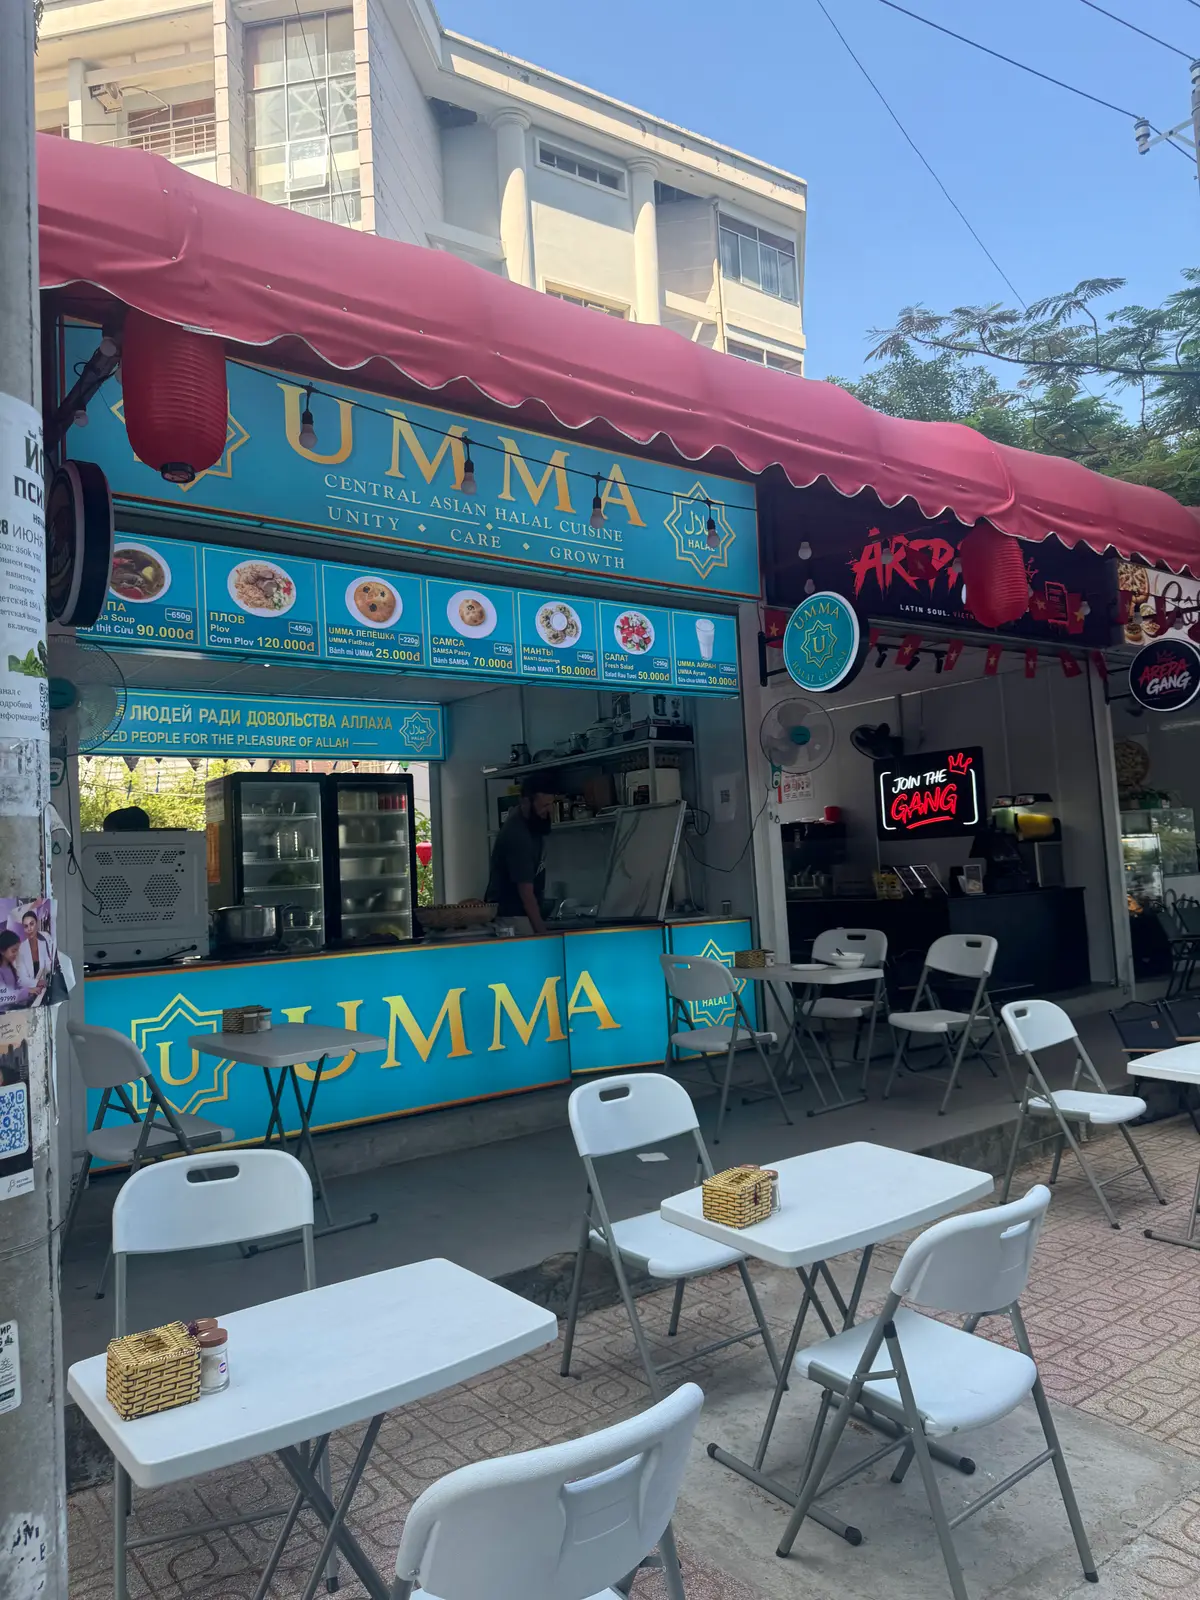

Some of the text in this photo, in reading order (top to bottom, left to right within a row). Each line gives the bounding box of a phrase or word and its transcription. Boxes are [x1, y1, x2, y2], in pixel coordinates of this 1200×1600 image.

[277, 383, 647, 527] UMMA
[324, 473, 623, 543] CENTRAL ASIAN HALAL CUISINE
[328, 506, 625, 570] UNITY CARE GROWTH
[689, 539, 715, 552] HALA
[794, 602, 839, 630] UMMA
[900, 604, 923, 613] LATIN
[927, 608, 949, 617] SOUL.
[111, 613, 135, 624] Soup
[209, 611, 245, 624] ПЛОВ
[136, 624, 194, 640] 90.000đ
[210, 623, 230, 633] Plov
[328, 627, 395, 640] UMMA ЛЕПЁШКА
[234, 636, 254, 646] Plov
[257, 636, 315, 652] 120.000đ
[432, 636, 465, 647] САМСА
[812, 635, 825, 653] U
[375, 648, 421, 661] 25.000đ
[523, 647, 554, 656] МАНТЫ
[604, 652, 629, 662] САЛАТ
[473, 656, 513, 669] 70.000đ
[556, 665, 597, 677] 150.000đ
[638, 671, 670, 681] 50.000đ
[1138, 658, 1189, 689] AREPA
[707, 676, 736, 686] 30.000đ
[1146, 670, 1192, 695] GANG
[130, 704, 193, 725] ЛЮДЕЙ
[199, 708, 241, 727] РАДИ
[246, 710, 337, 729] ДОВОЛЬСТВА
[341, 715, 393, 731] АЛЛАХА
[131, 731, 181, 744] PEOPLE
[184, 732, 208, 745] FOR
[211, 733, 234, 746] THE
[237, 734, 296, 748] PLEASURE
[298, 736, 313, 748] OF
[315, 737, 349, 749] ALLAH
[892, 769, 948, 794] JOIN THE
[891, 784, 957, 824] GANG
[702, 995, 728, 1008] HALAL
